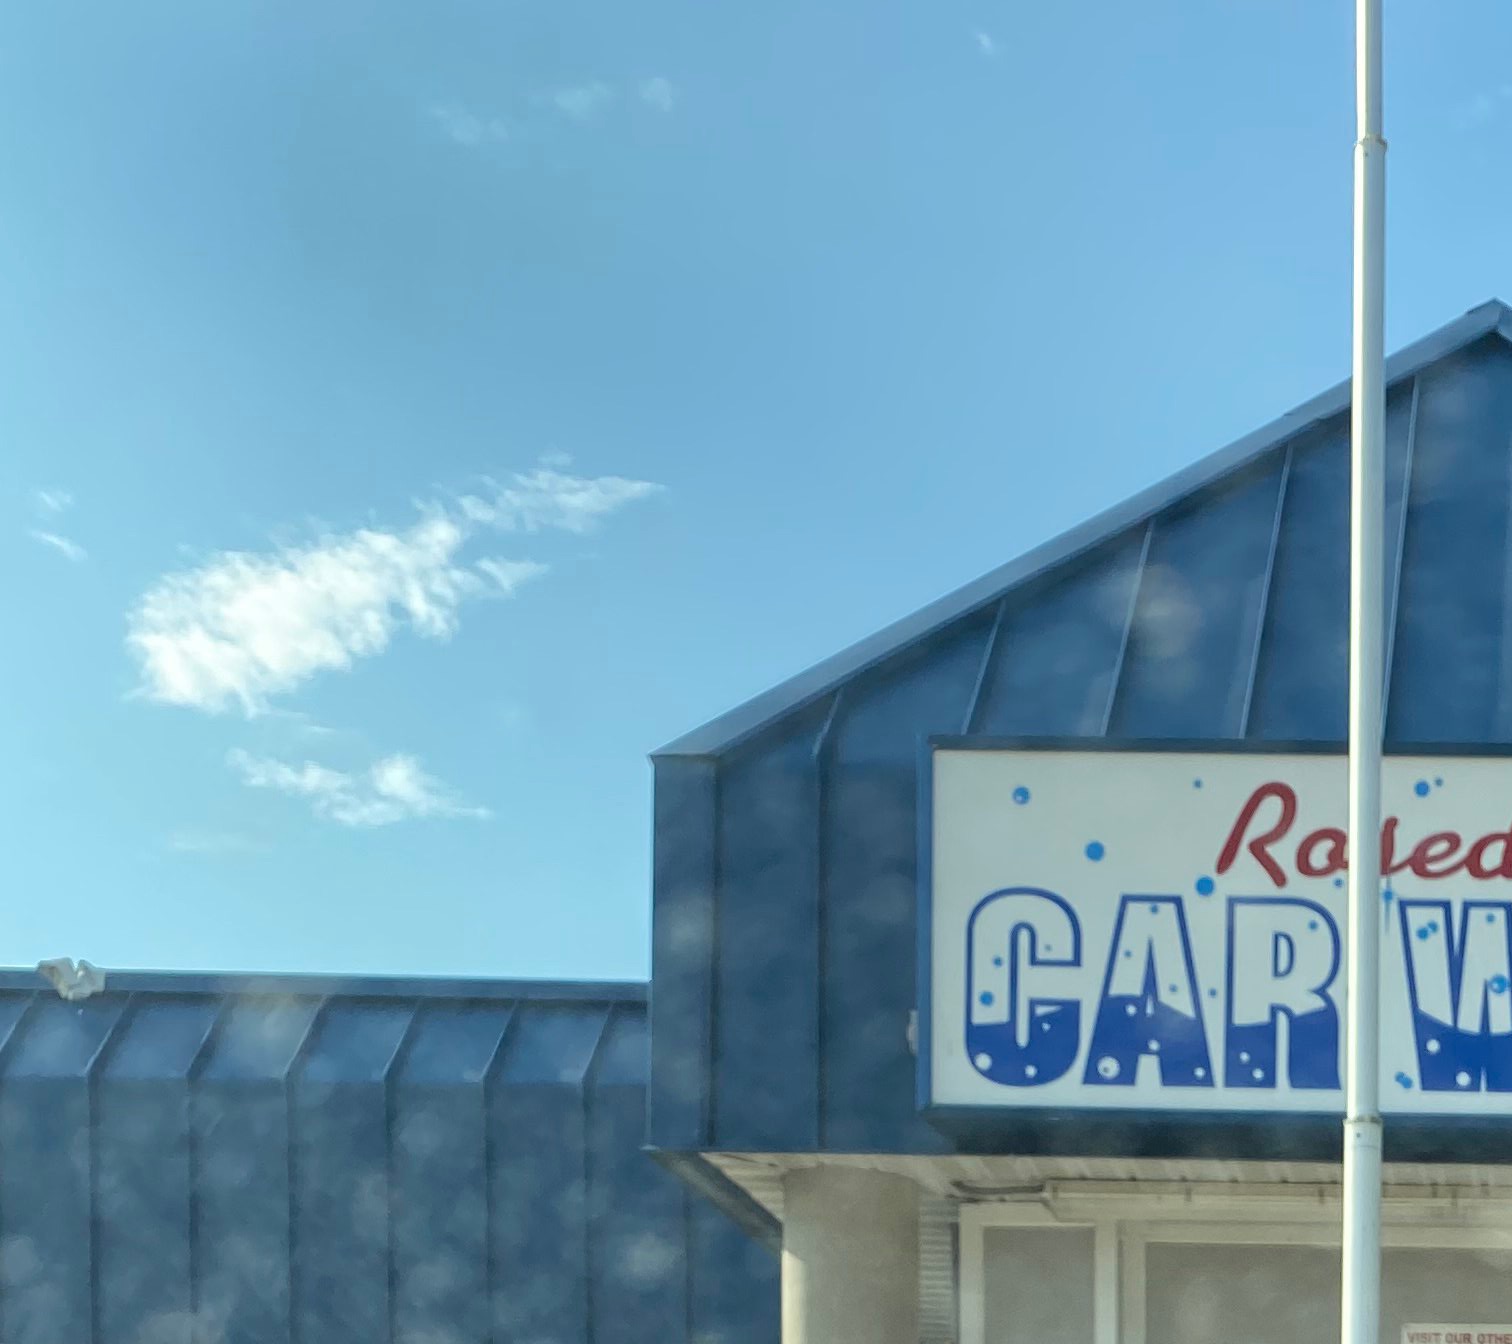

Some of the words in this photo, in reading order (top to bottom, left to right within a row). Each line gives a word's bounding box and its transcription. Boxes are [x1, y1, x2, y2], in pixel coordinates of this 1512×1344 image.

[965, 885, 1342, 1088] CAR
[1406, 1332, 1441, 1344] VISIT
[1445, 1333, 1472, 1344] OUR
